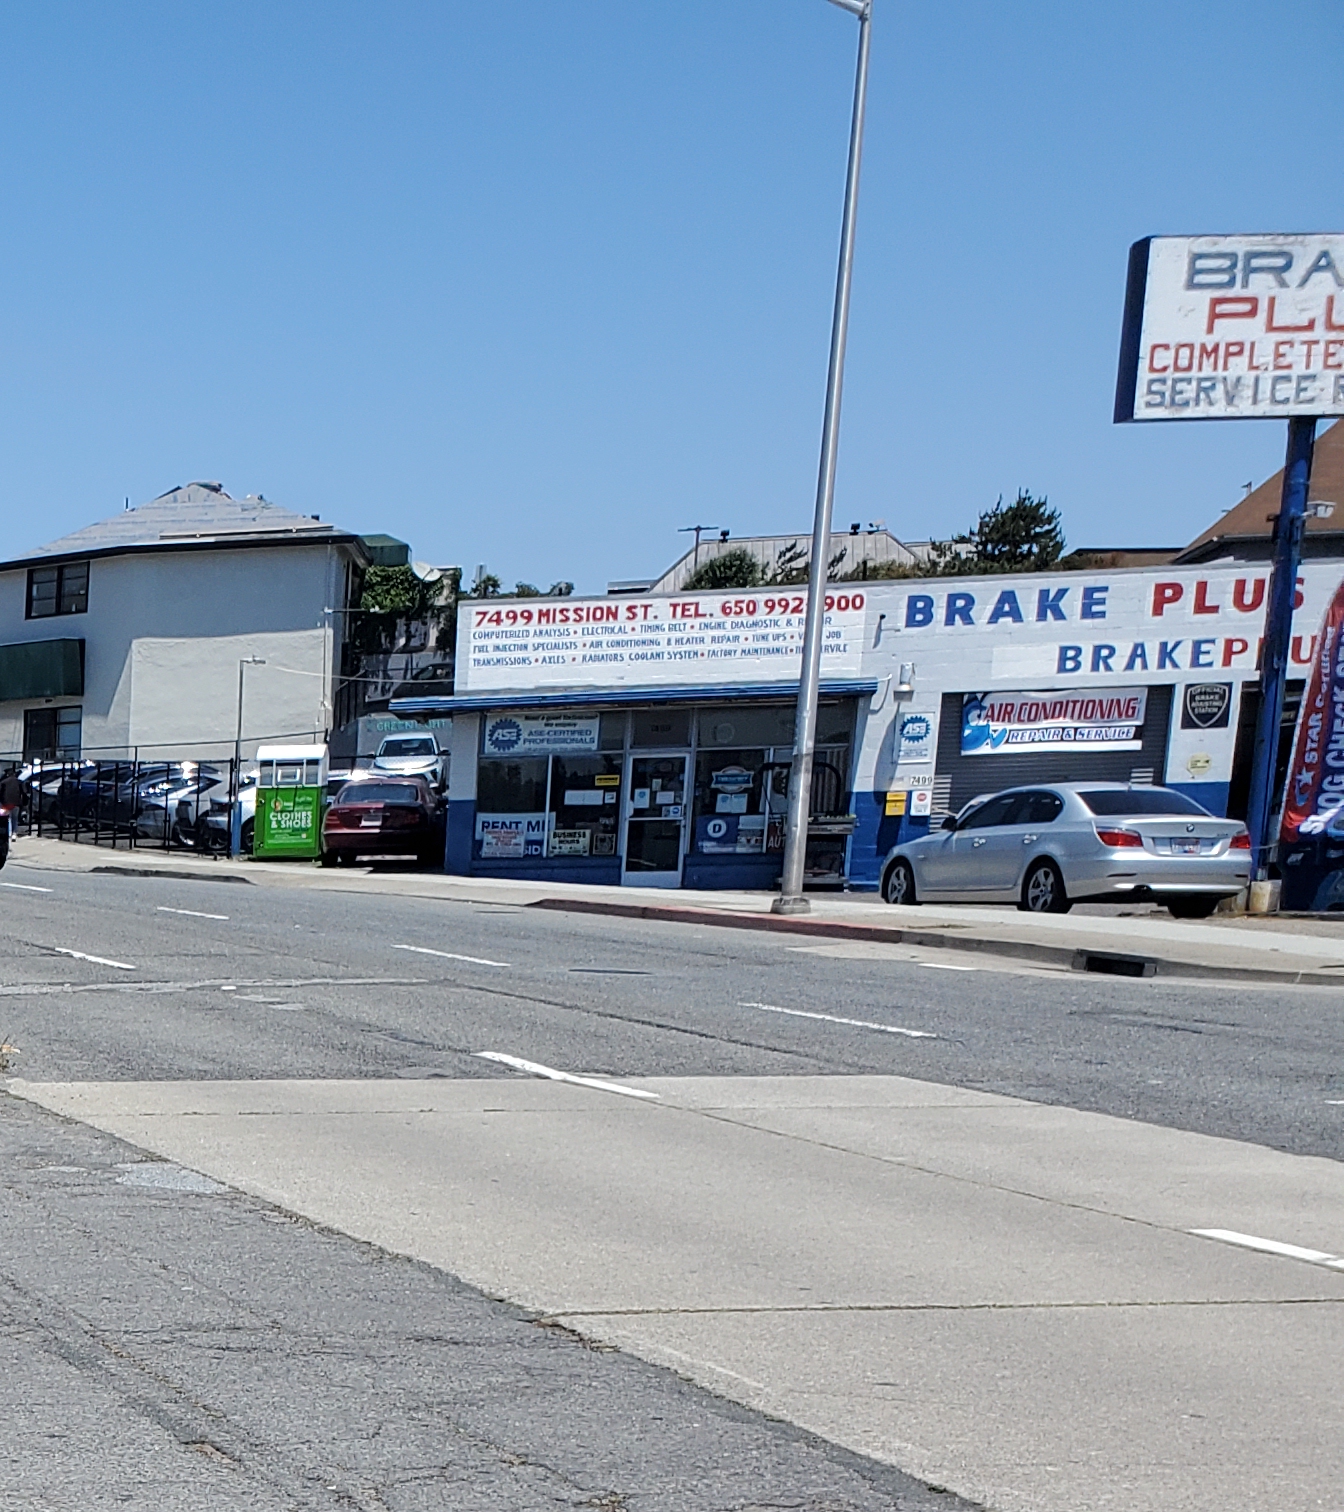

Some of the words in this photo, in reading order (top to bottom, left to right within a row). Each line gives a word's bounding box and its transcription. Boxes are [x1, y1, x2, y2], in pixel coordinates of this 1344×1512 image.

[1148, 339, 1344, 374] COMPLETE
[1145, 374, 1317, 409] SERVICE
[474, 609, 534, 628] 7499
[537, 605, 620, 625] MISSION
[625, 604, 658, 621] ST.
[669, 602, 714, 618] TEL.
[720, 599, 758, 617] 650
[904, 585, 1110, 629] BRAKE
[472, 629, 530, 640] COMPUTERIZED
[532, 626, 571, 637] ANALYSIS
[581, 625, 628, 636] ELECTRICAL
[639, 624, 666, 634] TIMING
[667, 623, 687, 633] BELT
[699, 621, 728, 630] ENGINE
[730, 618, 781, 630] DIAGNOSTIC
[786, 618, 793, 627] &
[473, 643, 490, 653] FUEL
[492, 642, 529, 652] INJECTION
[532, 641, 578, 651] SPECIALISTS
[589, 640, 603, 649] AIR
[606, 638, 661, 648] CONDITIONING
[675, 636, 706, 646] HEATER
[710, 635, 741, 644] REPAIR
[752, 633, 770, 643] TUNE
[772, 633, 787, 642] UPS
[825, 630, 842, 640] JOB
[473, 656, 532, 667] TRANSMISSIONS
[541, 655, 566, 665] AXLES
[581, 653, 624, 663] RADIATORS
[628, 651, 664, 662] COOLANT
[667, 650, 699, 660] SYSTEM
[707, 648, 737, 659] FACTORY
[740, 646, 789, 657] MAINTENANCE
[982, 701, 1012, 723] AIR
[1014, 697, 1140, 724] CONDITIONING
[492, 728, 518, 741] ASE
[903, 722, 927, 735] ASE
[1008, 726, 1062, 743] REPAIR
[1062, 726, 1074, 741] &
[1075, 726, 1135, 741] SERVICE
[1304, 711, 1323, 765] STAR
[269, 811, 313, 820] CLOTHES
[270, 820, 278, 828] &
[280, 819, 313, 828] SHOES
